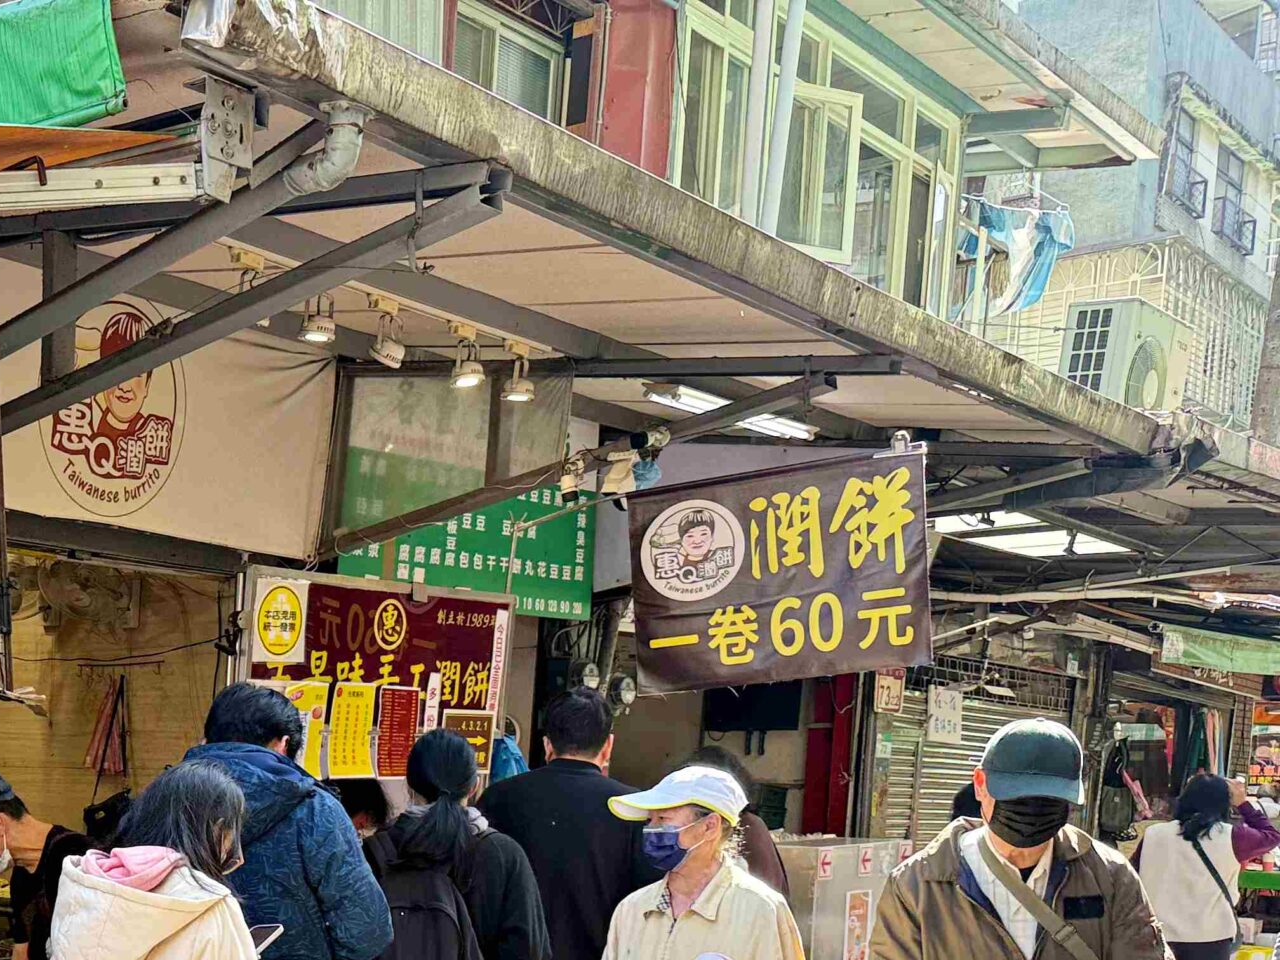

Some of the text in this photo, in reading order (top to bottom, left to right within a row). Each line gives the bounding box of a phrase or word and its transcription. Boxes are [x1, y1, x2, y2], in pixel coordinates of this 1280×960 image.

[62, 458, 161, 503] Taiwanese burrito
[748, 467, 915, 579] 潤餅
[663, 569, 731, 594] Taiwanese burrito
[649, 586, 915, 666] 一卷60元
